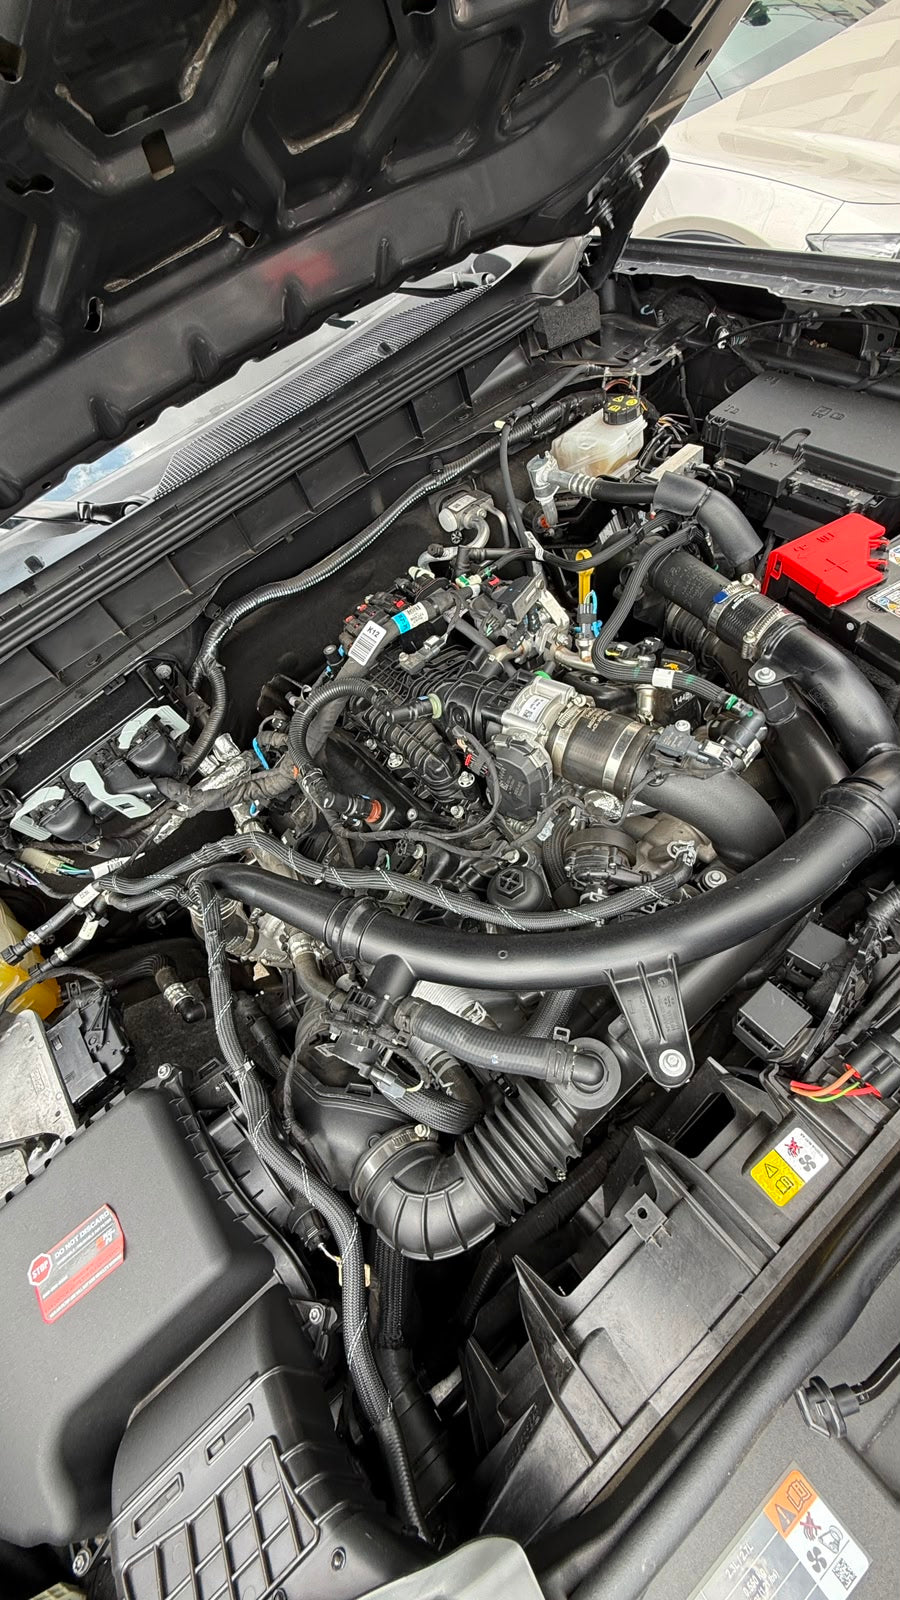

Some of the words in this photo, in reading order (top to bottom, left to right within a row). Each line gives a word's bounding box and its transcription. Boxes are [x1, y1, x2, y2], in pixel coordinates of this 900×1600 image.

[367, 626, 380, 638] K12
[55, 1248, 65, 1260] DO
[65, 1235, 80, 1250] NOT
[80, 1211, 109, 1237] DISCARD
[32, 1260, 48, 1279] STOP
[740, 1542, 754, 1560] 2.7L
